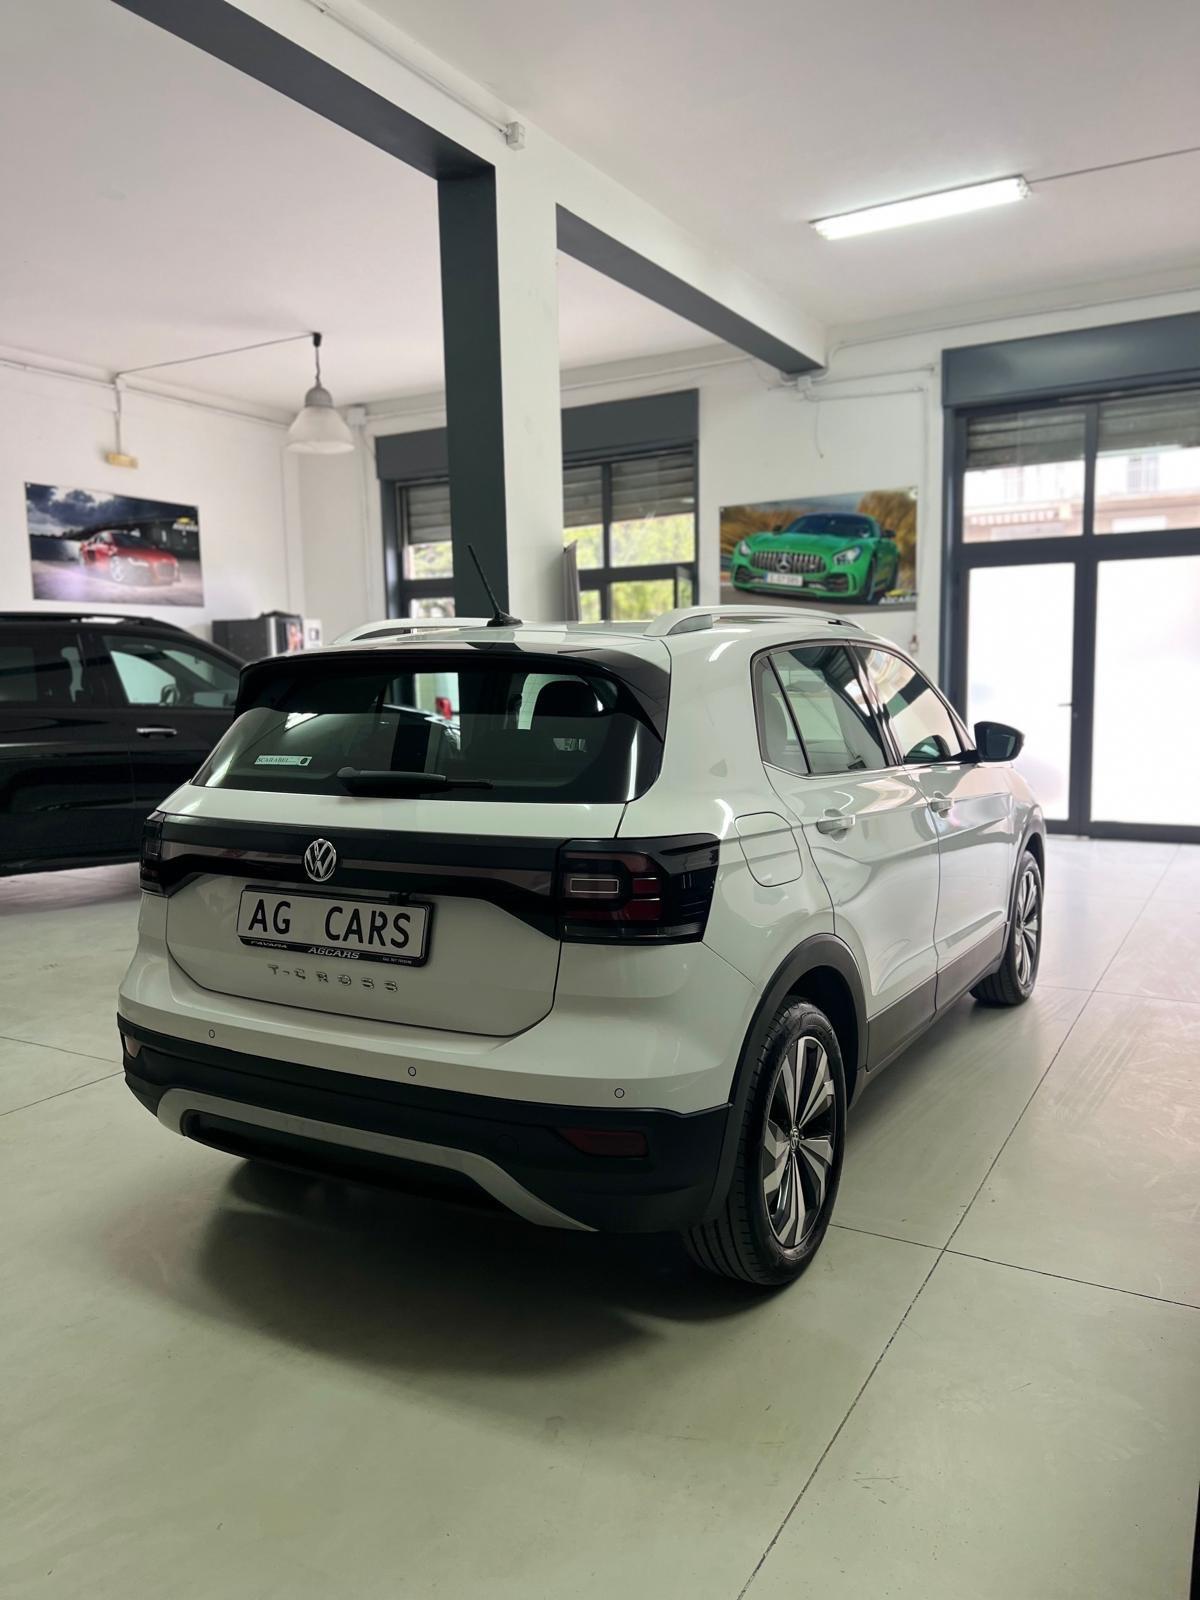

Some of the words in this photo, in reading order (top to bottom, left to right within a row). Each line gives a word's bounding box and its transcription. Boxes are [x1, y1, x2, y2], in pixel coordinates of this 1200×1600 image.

[248, 899, 291, 934] AG
[325, 906, 411, 949] CARS
[308, 945, 360, 960] AGCARS
[267, 963, 398, 992] T-CROSS
